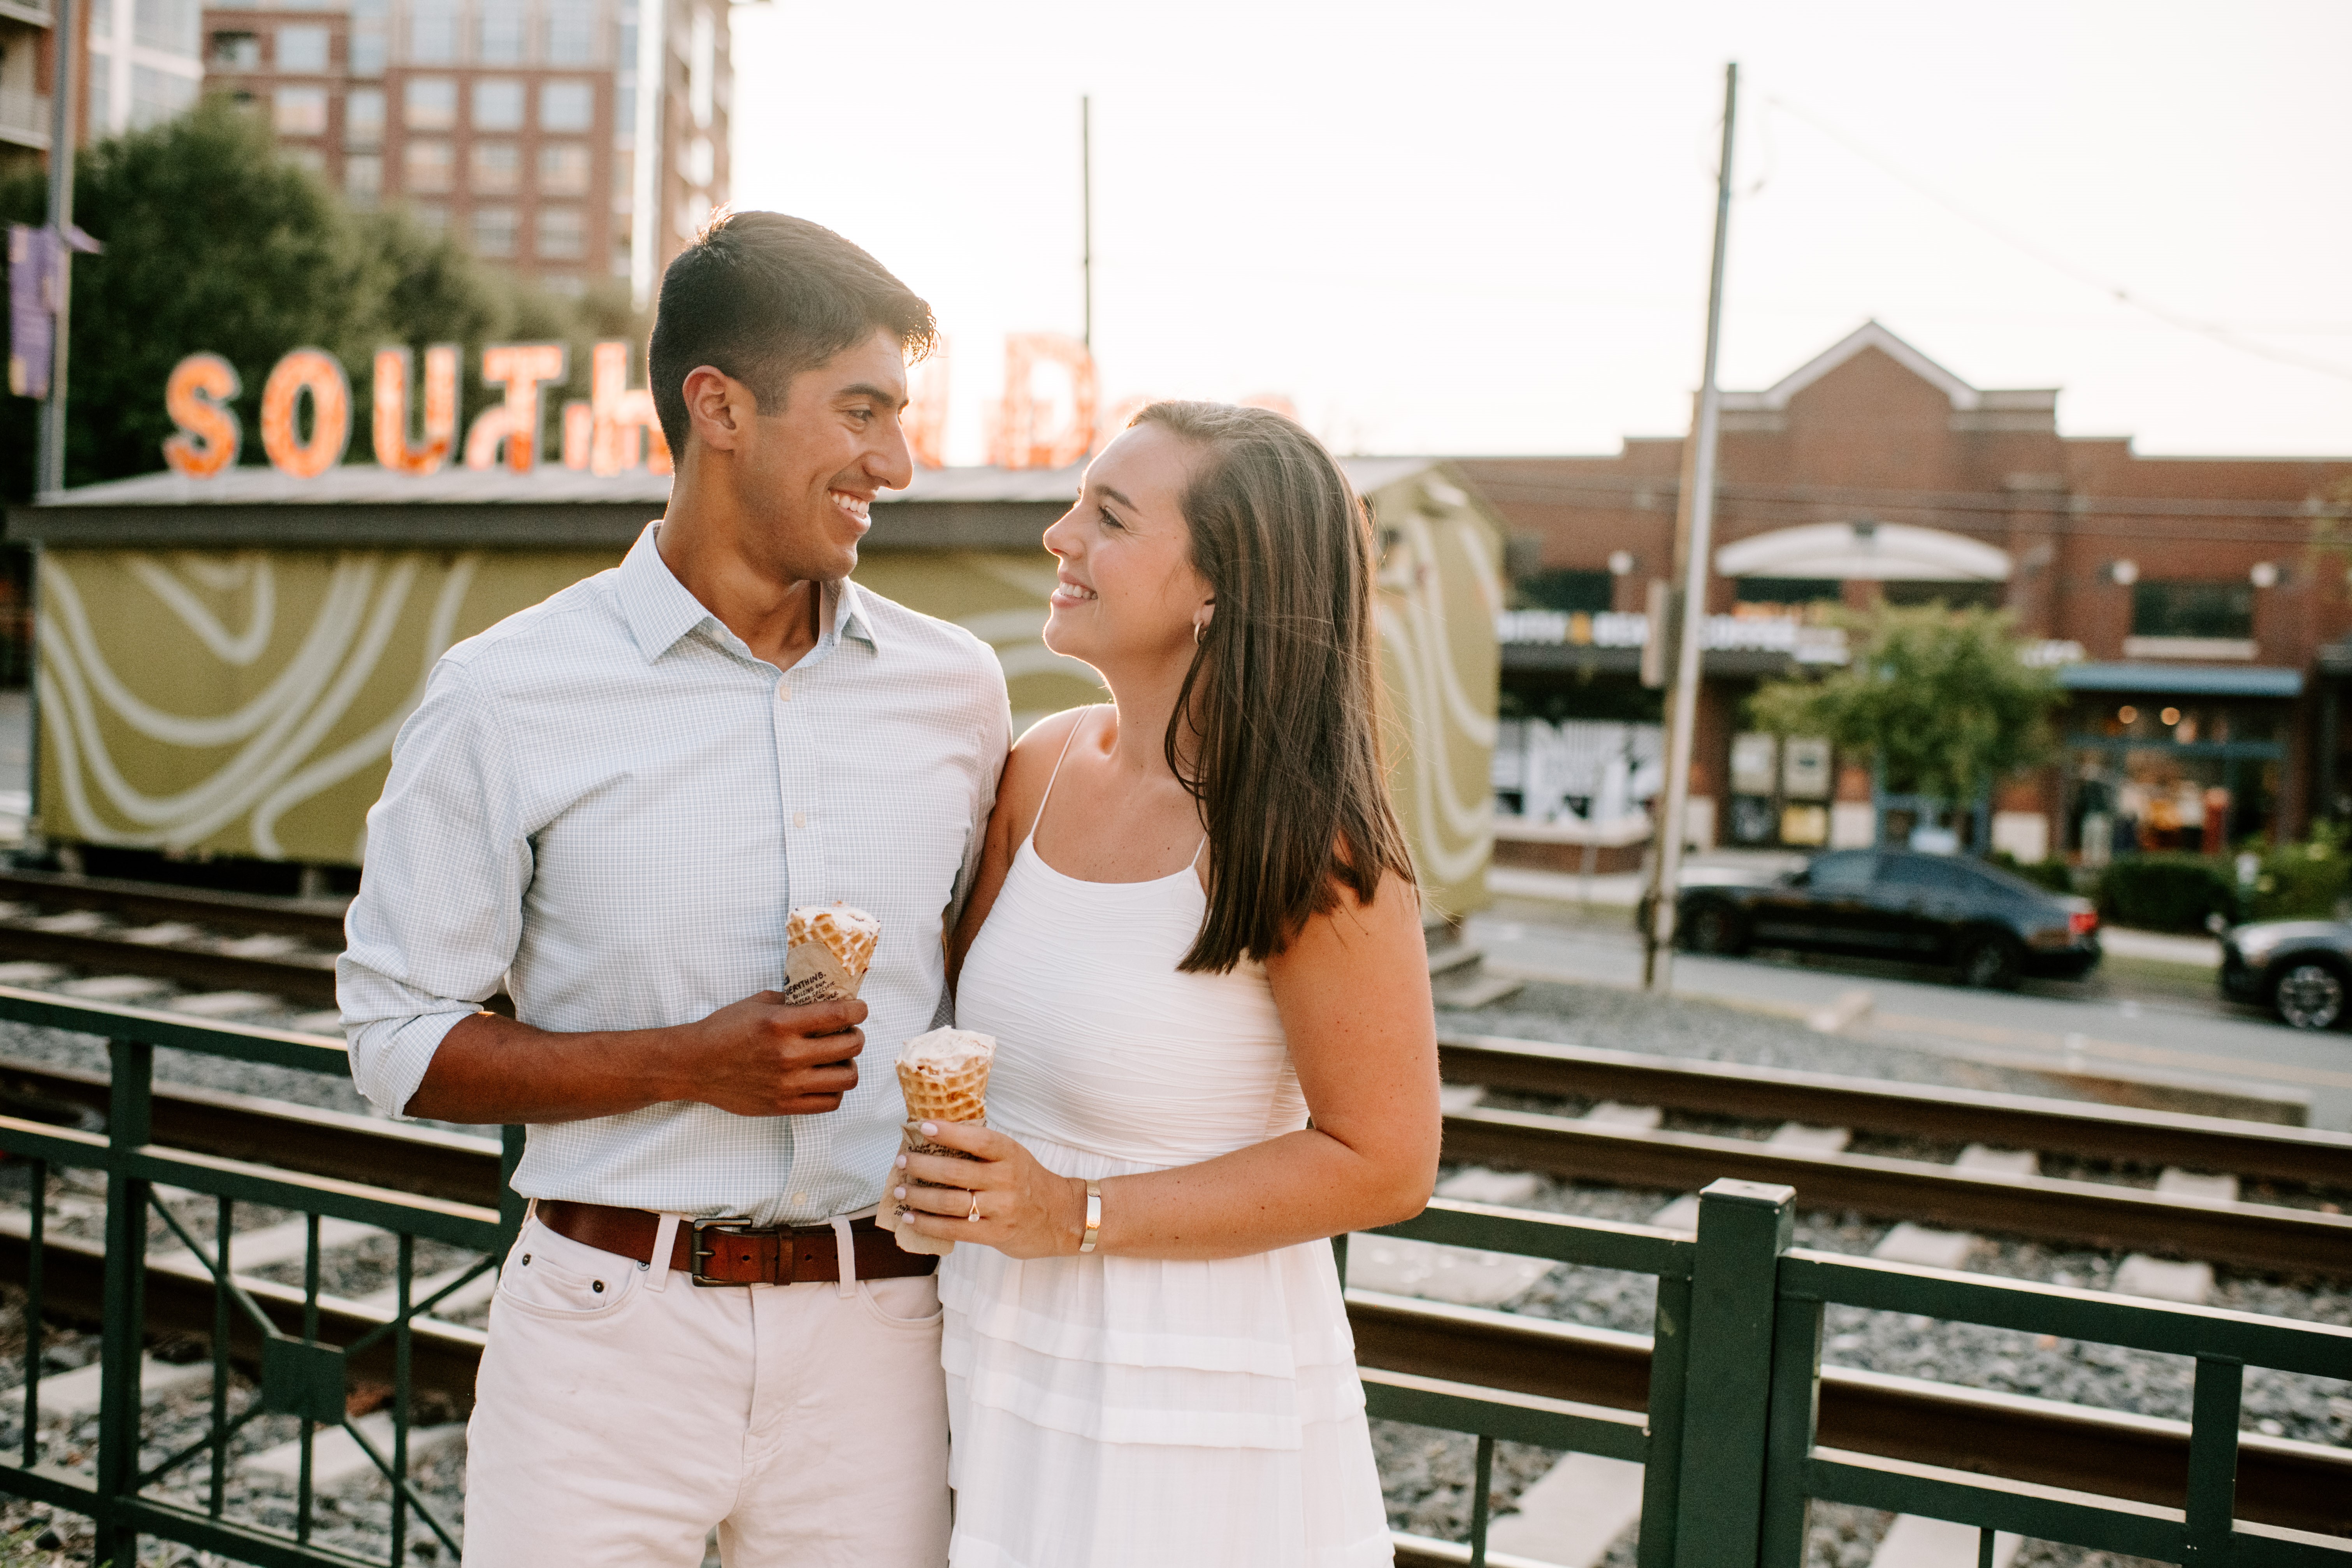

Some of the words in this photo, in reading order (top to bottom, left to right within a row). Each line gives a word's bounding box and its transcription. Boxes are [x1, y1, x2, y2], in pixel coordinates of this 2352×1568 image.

[785, 972, 826, 995] VERYTHING.
[792, 986, 814, 1000] BUILDING
[815, 980, 826, 989] OUR
[812, 981, 835, 997] SPECIFIC
